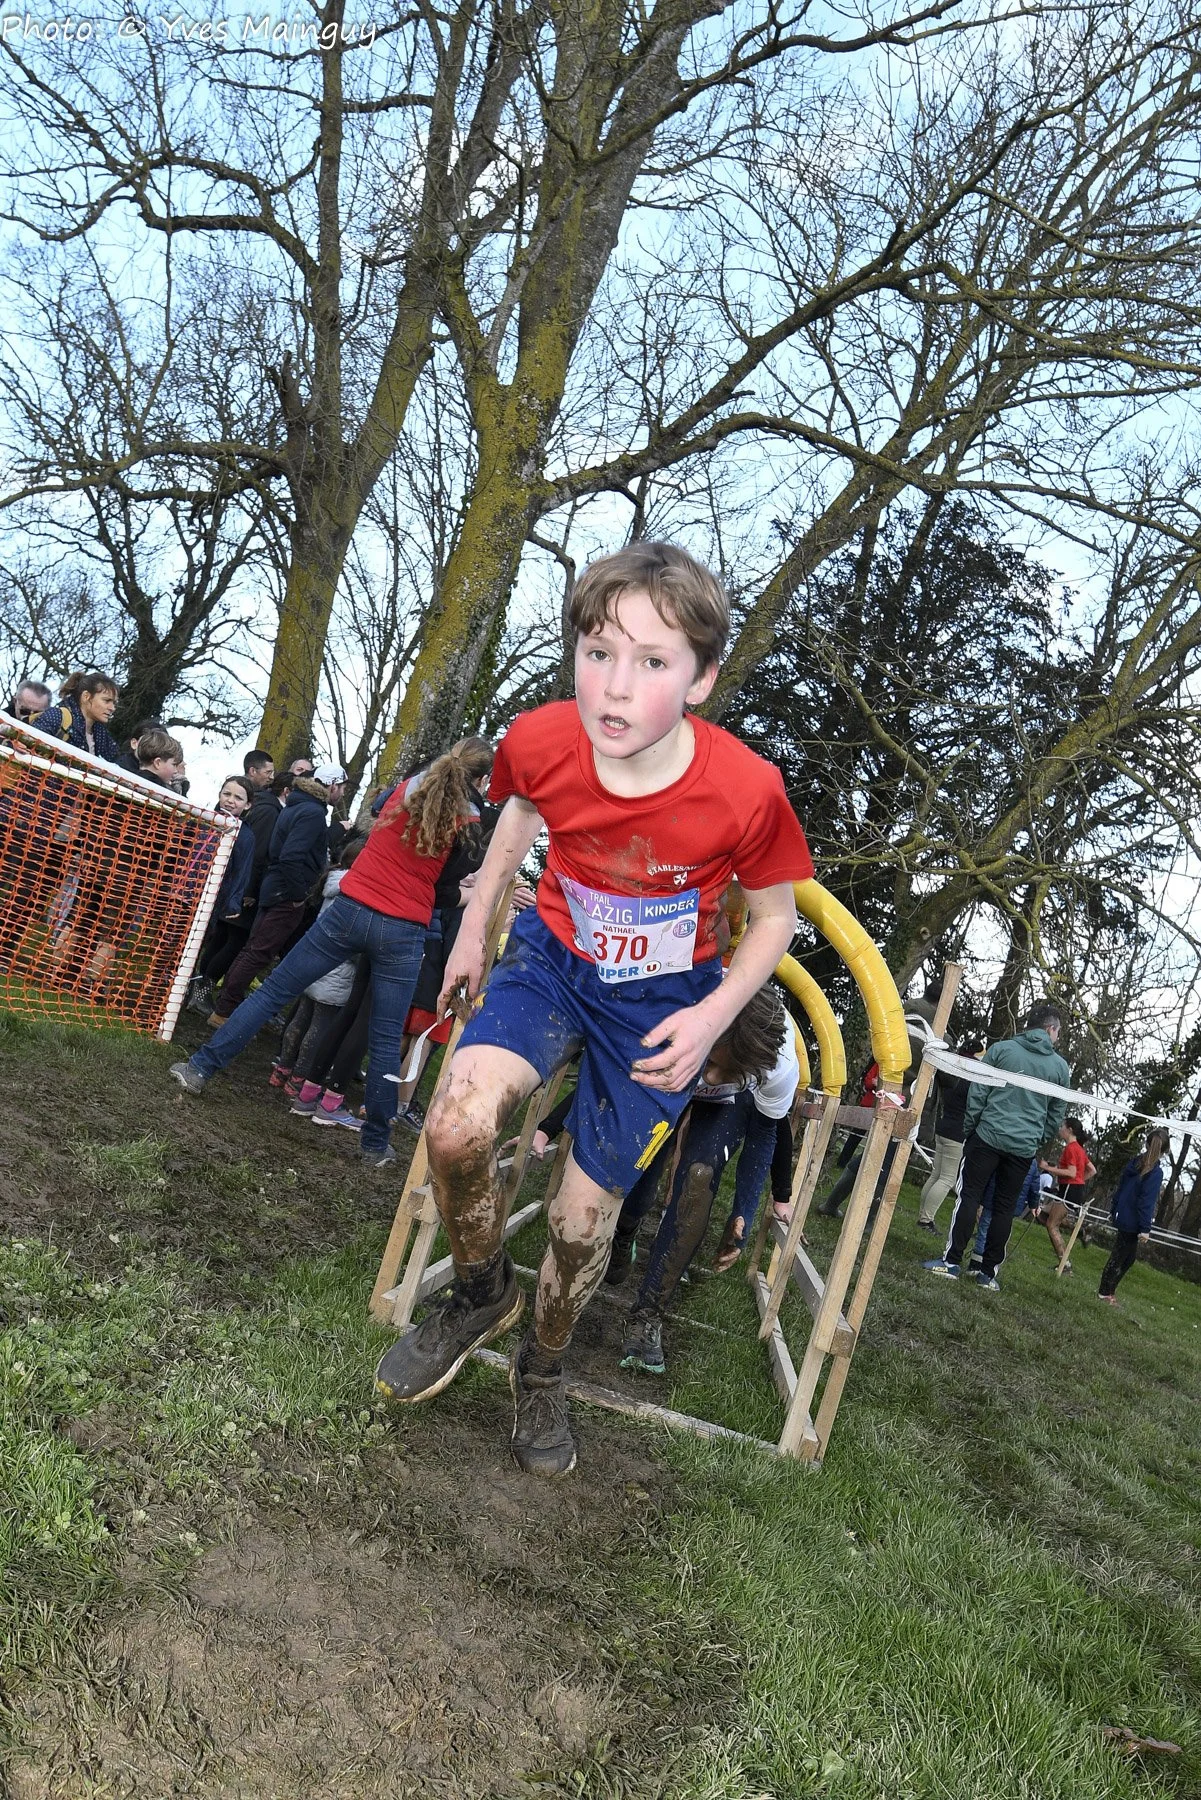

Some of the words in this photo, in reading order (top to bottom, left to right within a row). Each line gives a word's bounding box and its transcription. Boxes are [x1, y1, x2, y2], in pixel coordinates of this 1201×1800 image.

[590, 892, 612, 906] TRAIL
[644, 899, 695, 918] KINDER
[602, 925, 637, 935] NATHAEL
[592, 931, 649, 964] 370
[596, 965, 639, 979] UPER
